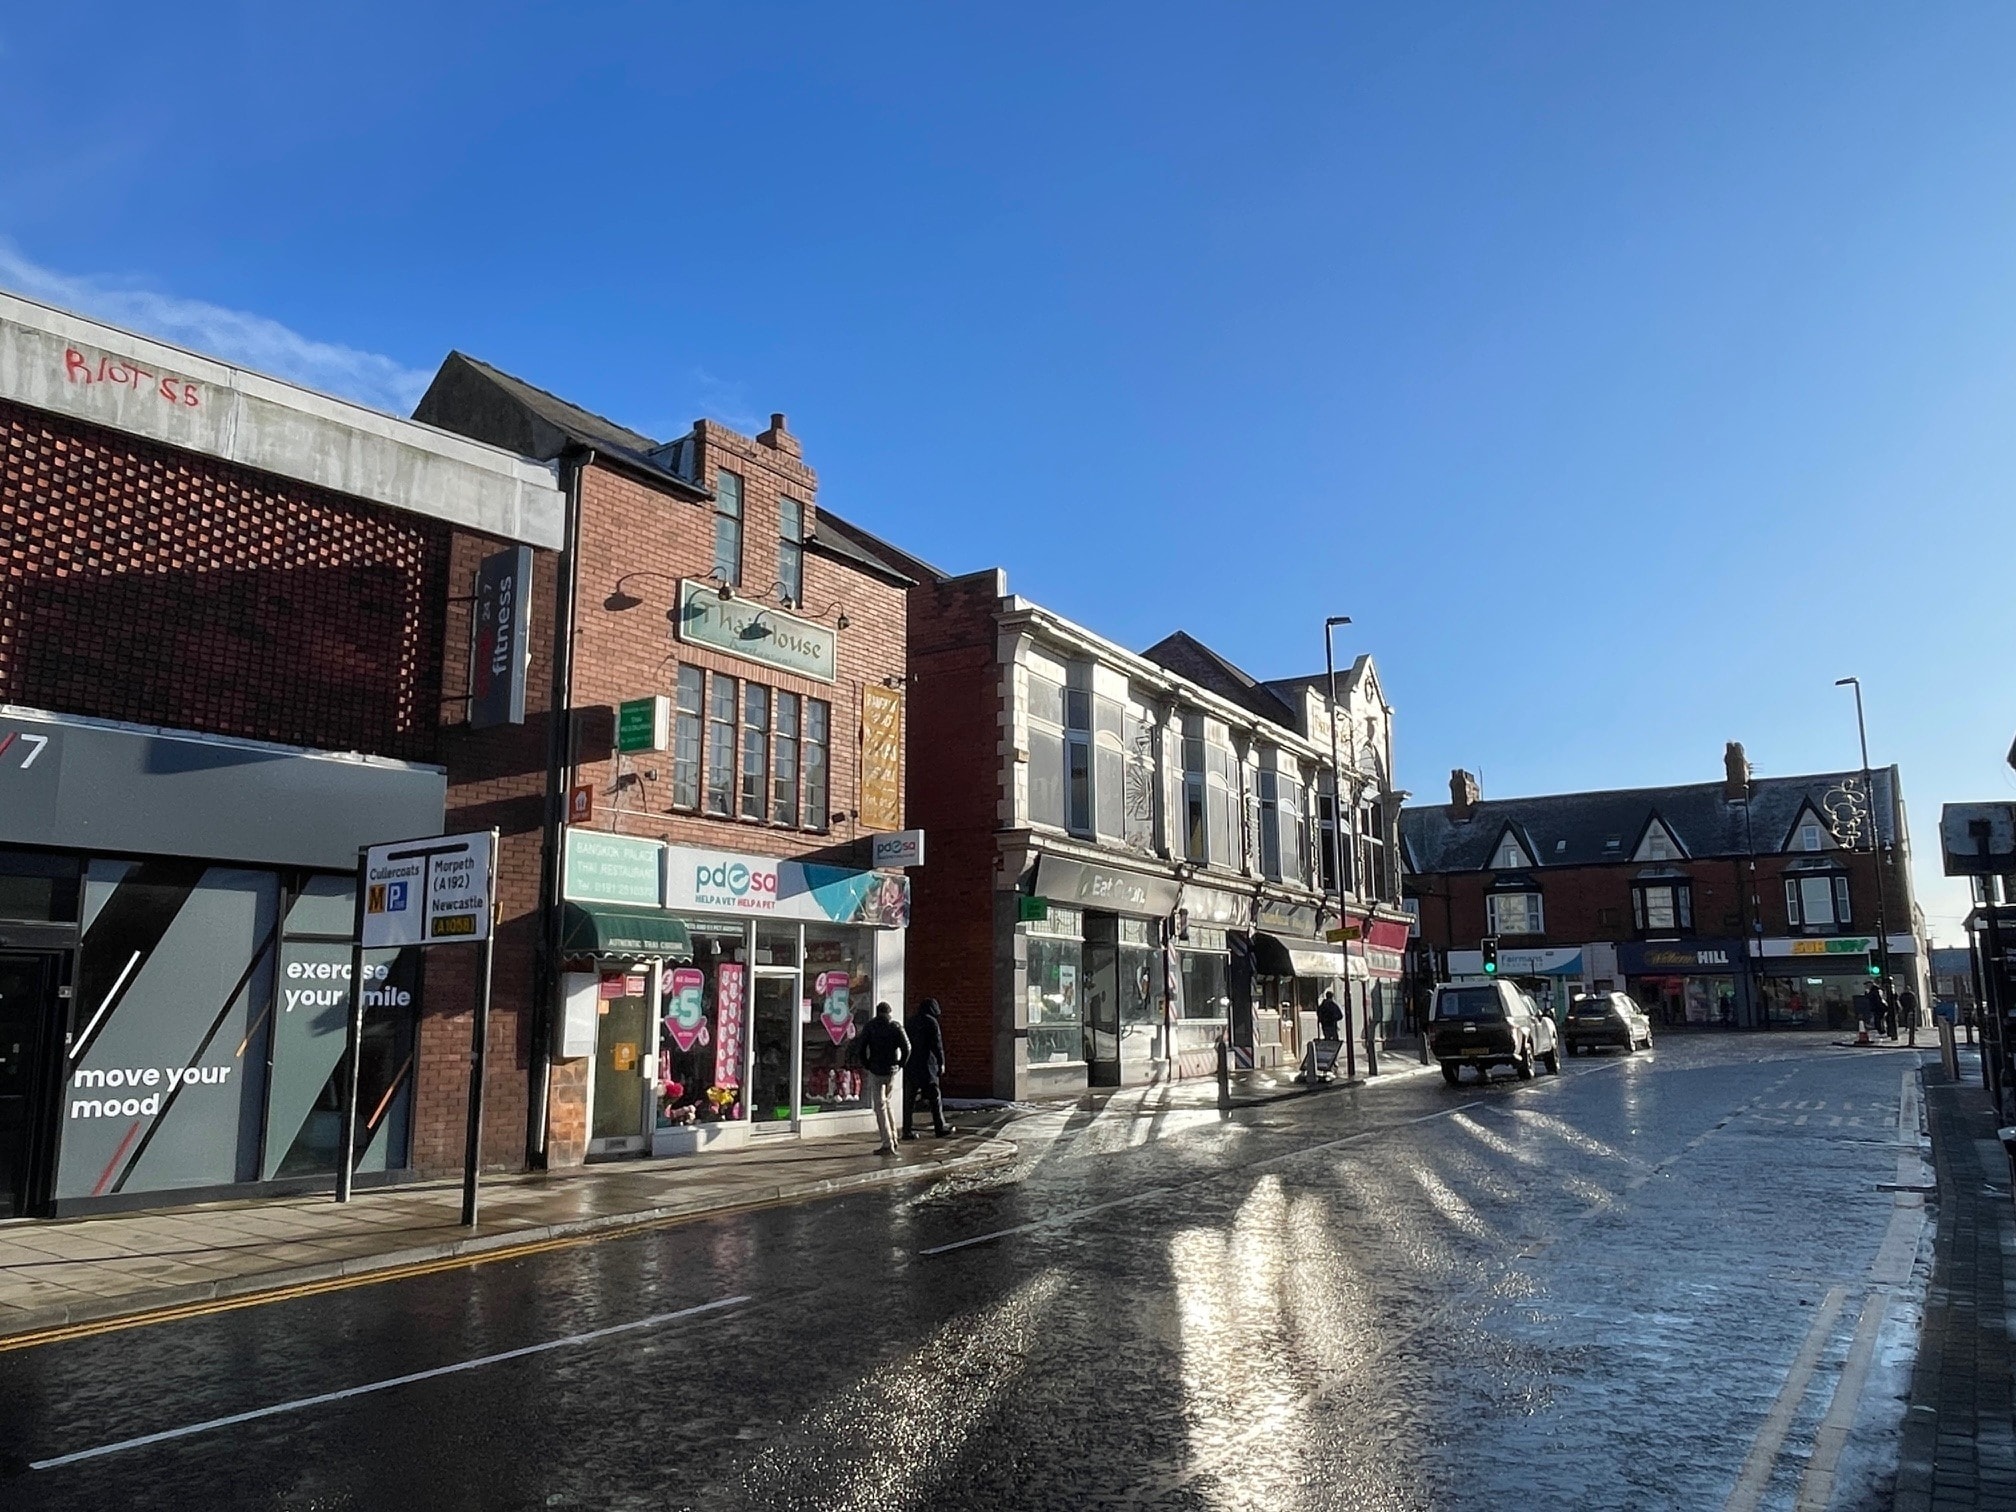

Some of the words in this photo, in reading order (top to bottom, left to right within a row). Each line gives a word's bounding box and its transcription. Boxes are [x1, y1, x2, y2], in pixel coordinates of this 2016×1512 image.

[65, 347, 153, 390] RIOT
[492, 576, 512, 675] fitness
[761, 620, 822, 659] House
[369, 864, 420, 881] Cullercoats
[434, 857, 475, 874] Morpeth
[434, 872, 470, 892] (A192)
[1092, 875, 1113, 897] Eat
[432, 896, 484, 912] Newcastle
[695, 894, 715, 904] HELP
[721, 897, 736, 906] VET
[737, 899, 756, 908] HELP
[762, 901, 776, 909] PET
[1501, 954, 1543, 965] Fairmans
[1697, 950, 1729, 964] HILL
[286, 962, 389, 980] exercse
[285, 989, 343, 1012] your
[362, 986, 411, 1006] mile
[74, 1067, 160, 1088] move
[165, 1066, 232, 1093] your
[71, 1092, 160, 1118] mood
